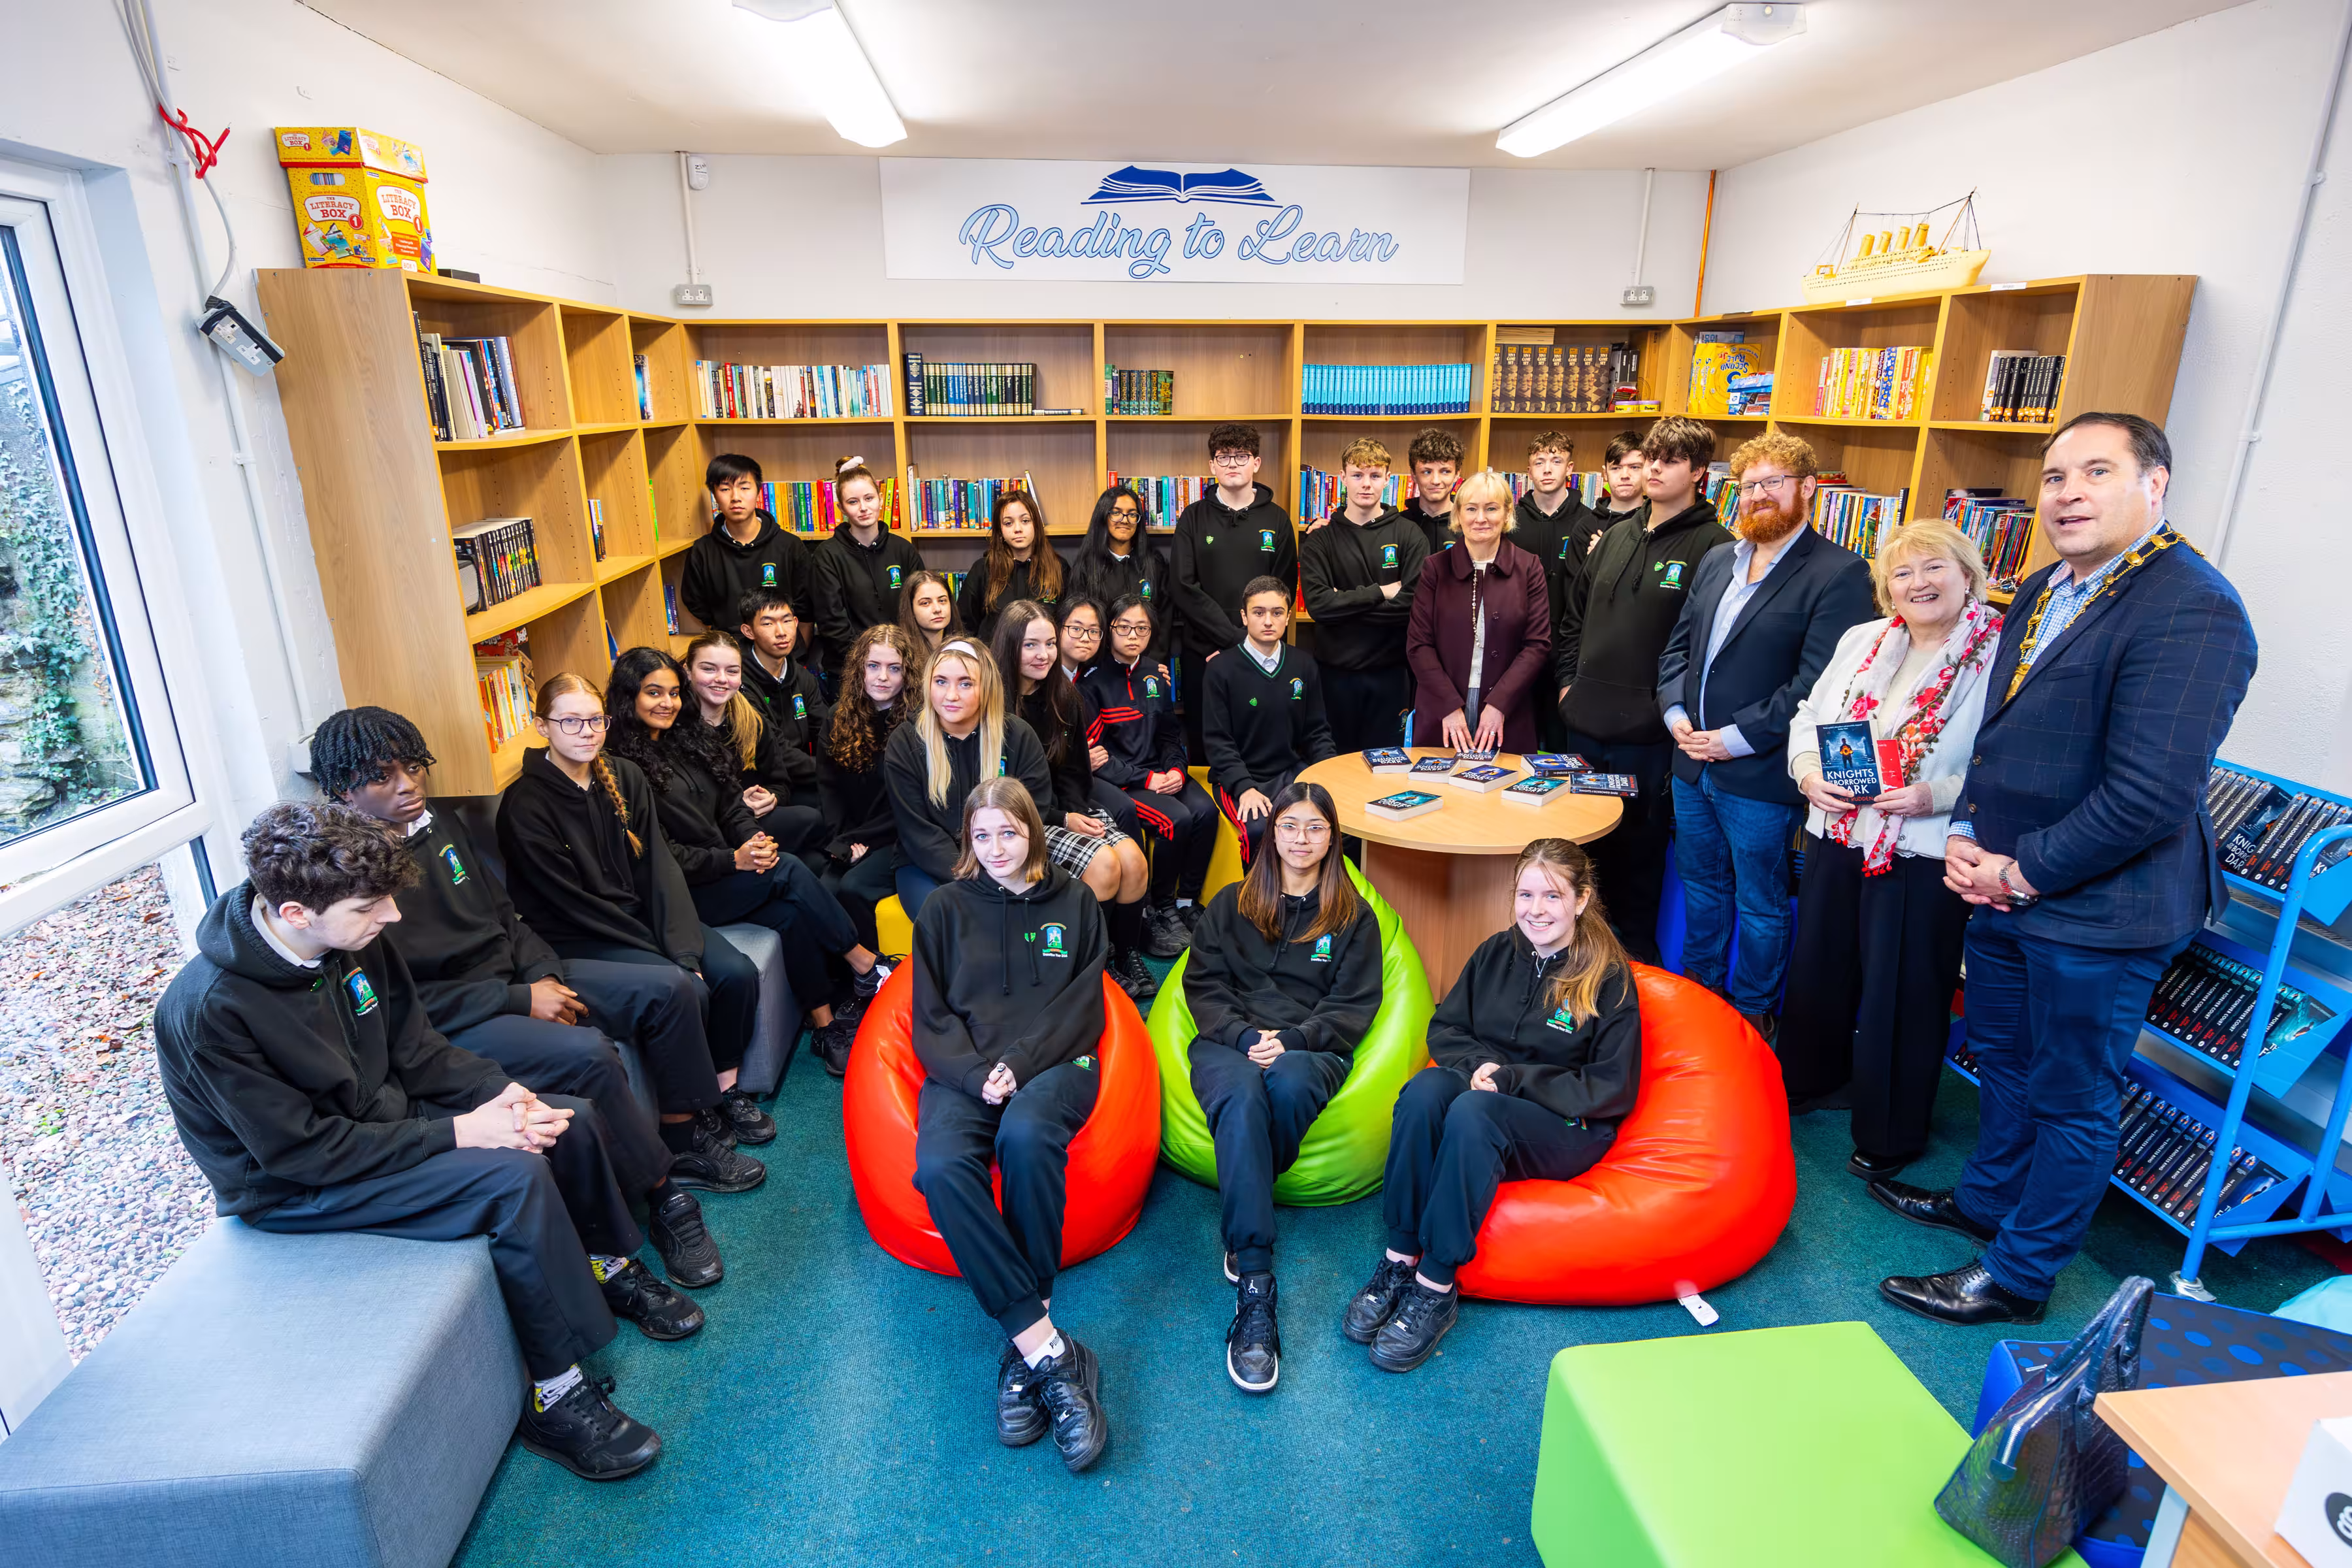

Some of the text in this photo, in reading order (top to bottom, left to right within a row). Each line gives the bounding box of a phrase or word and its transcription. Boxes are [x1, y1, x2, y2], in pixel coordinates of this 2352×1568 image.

[310, 201, 355, 210] LITERACY
[382, 194, 416, 209] LITERACY
[320, 209, 347, 218] BOX
[391, 204, 412, 220] BOX
[352, 217, 359, 227] 1
[416, 218, 421, 231] 1
[958, 204, 1399, 280] Reading to Learn
[1727, 353, 1746, 363] RULE
[1720, 362, 1749, 374] SECOND
[1827, 768, 1874, 780] KNIGHTS
[1833, 777, 1877, 786] BORROWED
[1847, 785, 1870, 794] ARK
[2248, 792, 2262, 808] KNIGHTS
[2219, 829, 2229, 840] DARK
[2257, 804, 2298, 853] KNIGHTS BORROWED DARK
[2271, 809, 2313, 858] KNIGHTS BORROWED DARK
[2232, 834, 2257, 854] KNIG
[2225, 853, 2245, 870] DAR
[2284, 853, 2296, 864] DARK
[2169, 988, 2180, 1001] COURT
[2181, 981, 2204, 1007] FOREVER COURT
[2202, 987, 2216, 1002] FOREVER
[2213, 992, 2229, 1007] FOREVER
[2192, 1001, 2204, 1014] COURT
[2227, 998, 2242, 1014] FOREVER
[2204, 1007, 2216, 1019] COURT
[2216, 1013, 2229, 1026] COURT
[2229, 1019, 2241, 1032] COURT
[2123, 1138, 2132, 1147] KING
[2135, 1146, 2144, 1155] KING
[2148, 1154, 2156, 1164] KING
[2159, 1149, 2180, 1171] ENDLESS KING
[2172, 1156, 2193, 1179] ENDLESS KING
[2183, 1166, 2205, 1188] ENDLESS KING
